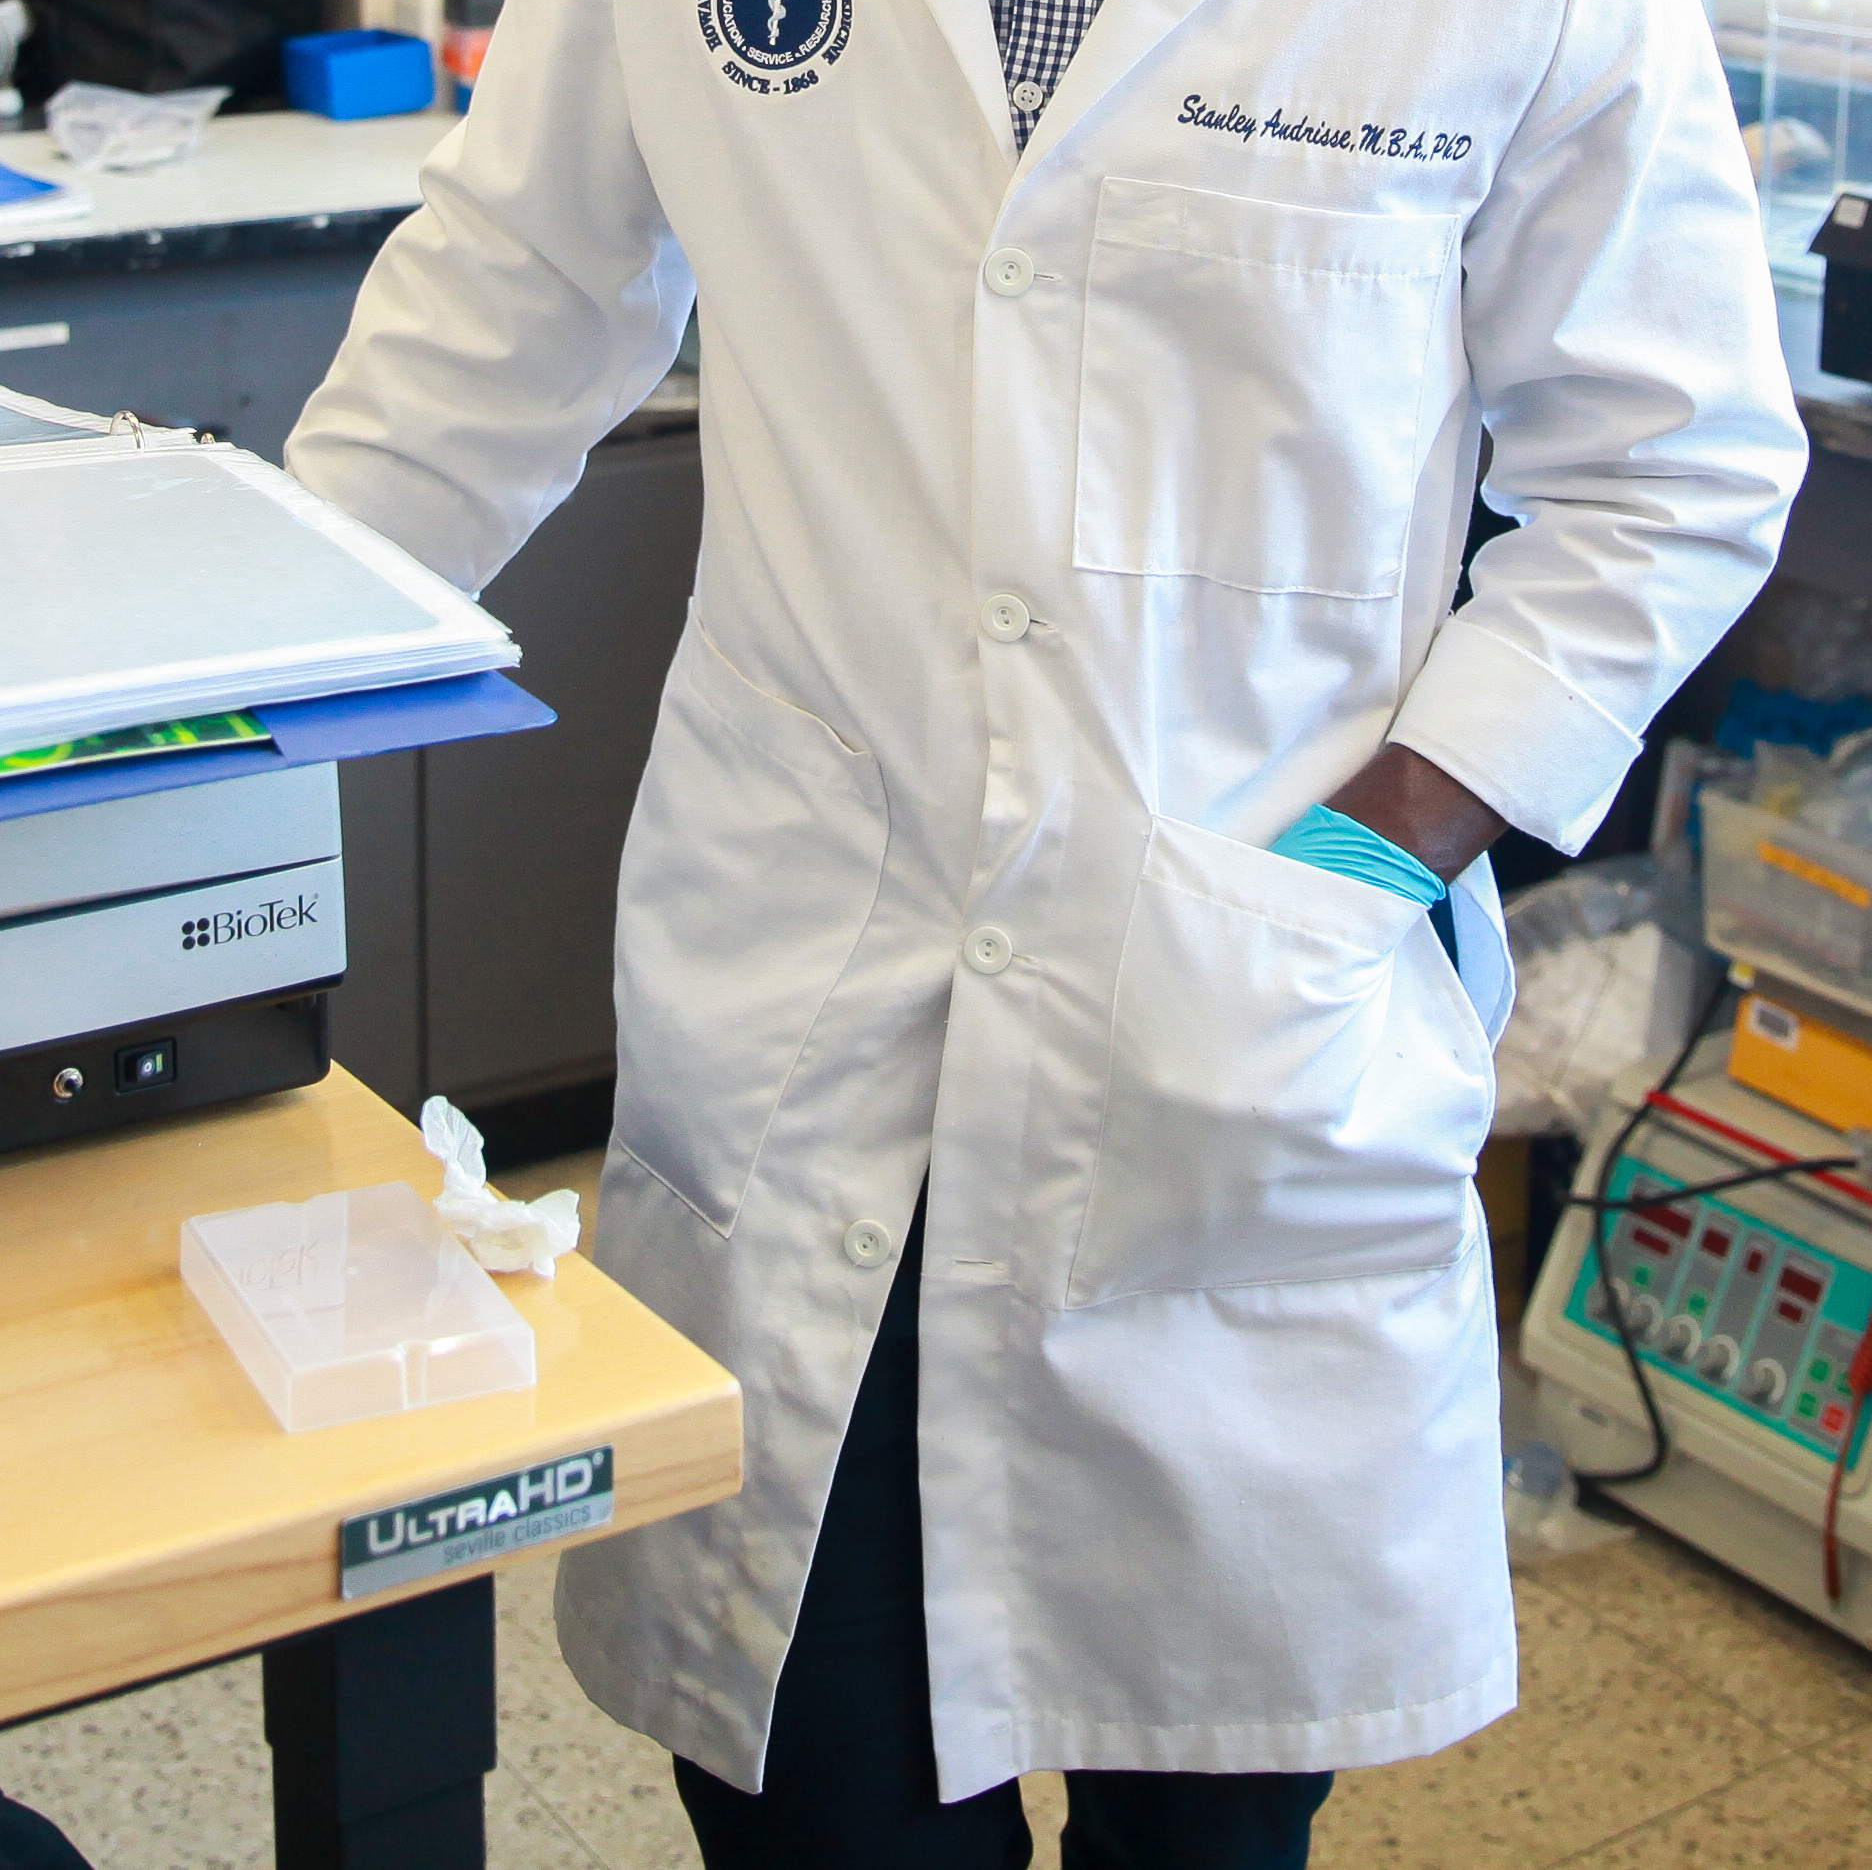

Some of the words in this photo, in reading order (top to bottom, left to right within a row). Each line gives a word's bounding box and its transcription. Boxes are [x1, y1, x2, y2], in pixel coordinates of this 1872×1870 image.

[747, 46, 795, 64] SERVICE
[722, 60, 770, 94] SINCE
[783, 69, 819, 94] 1868
[1178, 94, 1256, 142] Stanley
[1260, 108, 1354, 153] Andrisse,
[213, 894, 318, 945] BioTek
